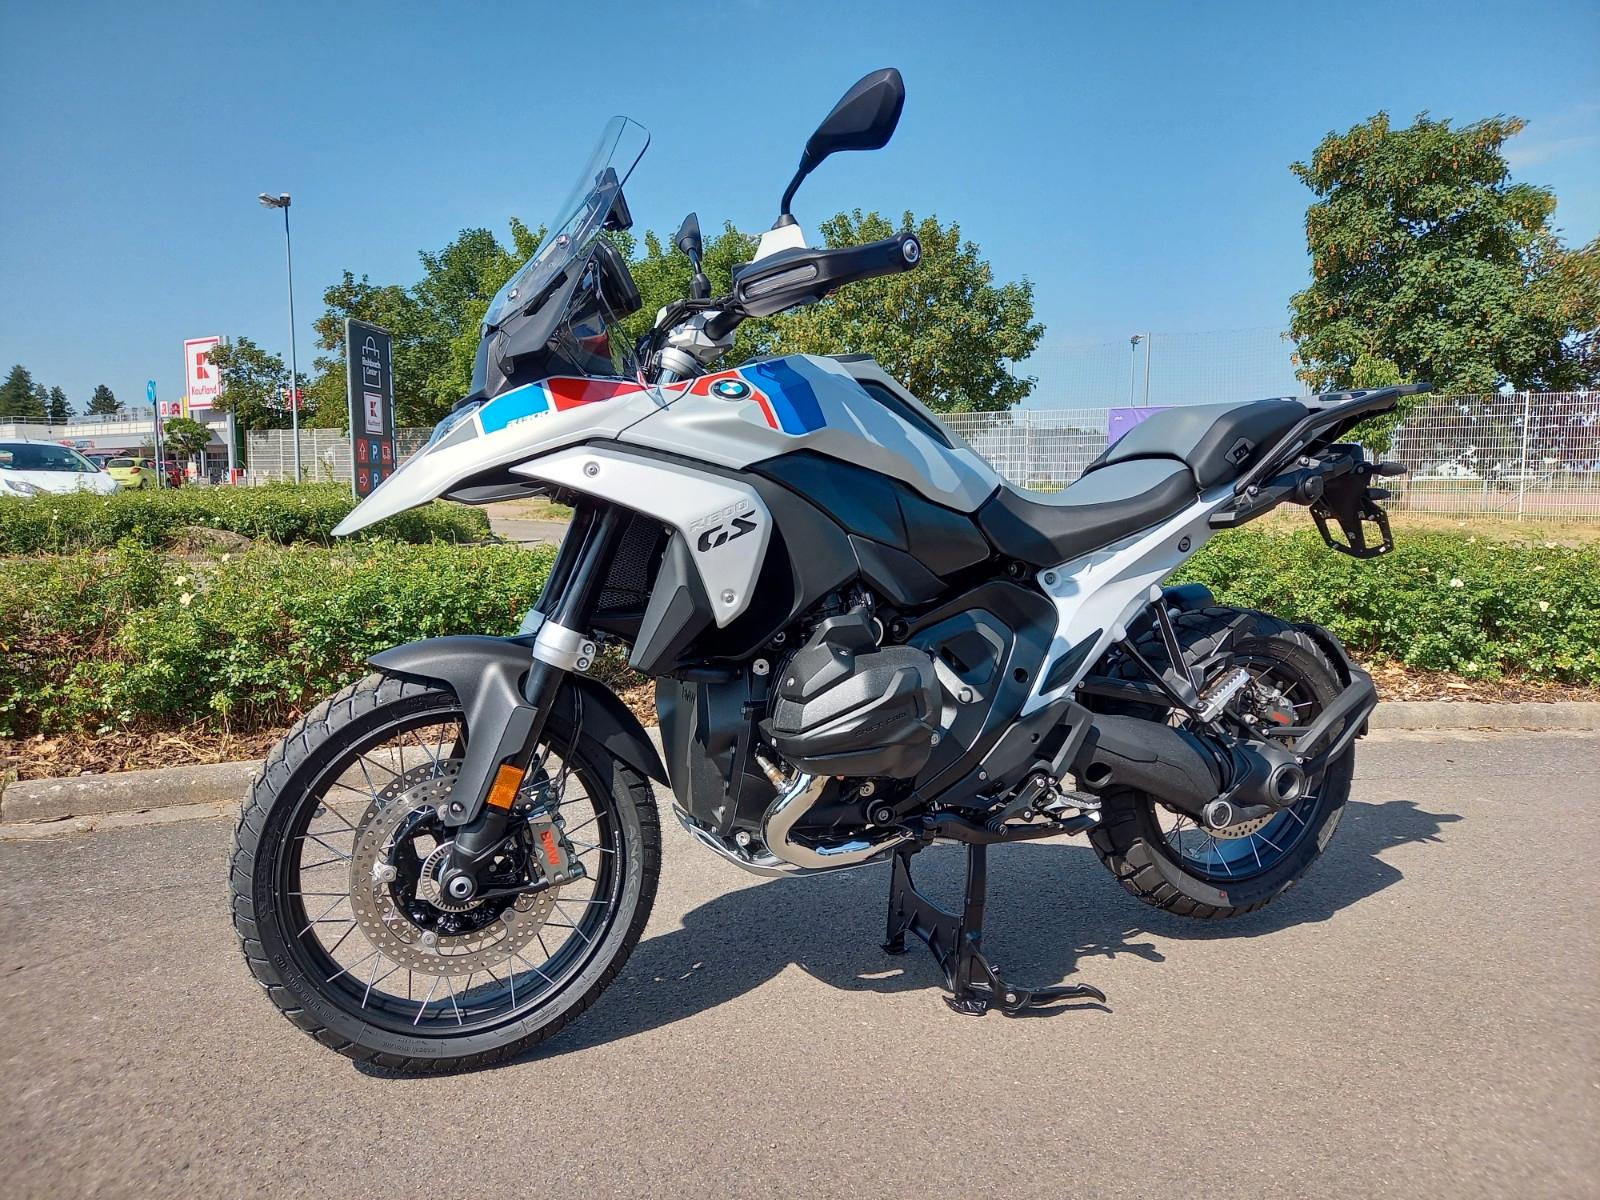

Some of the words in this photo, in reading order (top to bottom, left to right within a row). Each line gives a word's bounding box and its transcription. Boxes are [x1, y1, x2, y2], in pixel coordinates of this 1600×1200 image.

[191, 384, 217, 396] Kaufland
[698, 508, 757, 553] GS
[540, 830, 561, 865] BMW
